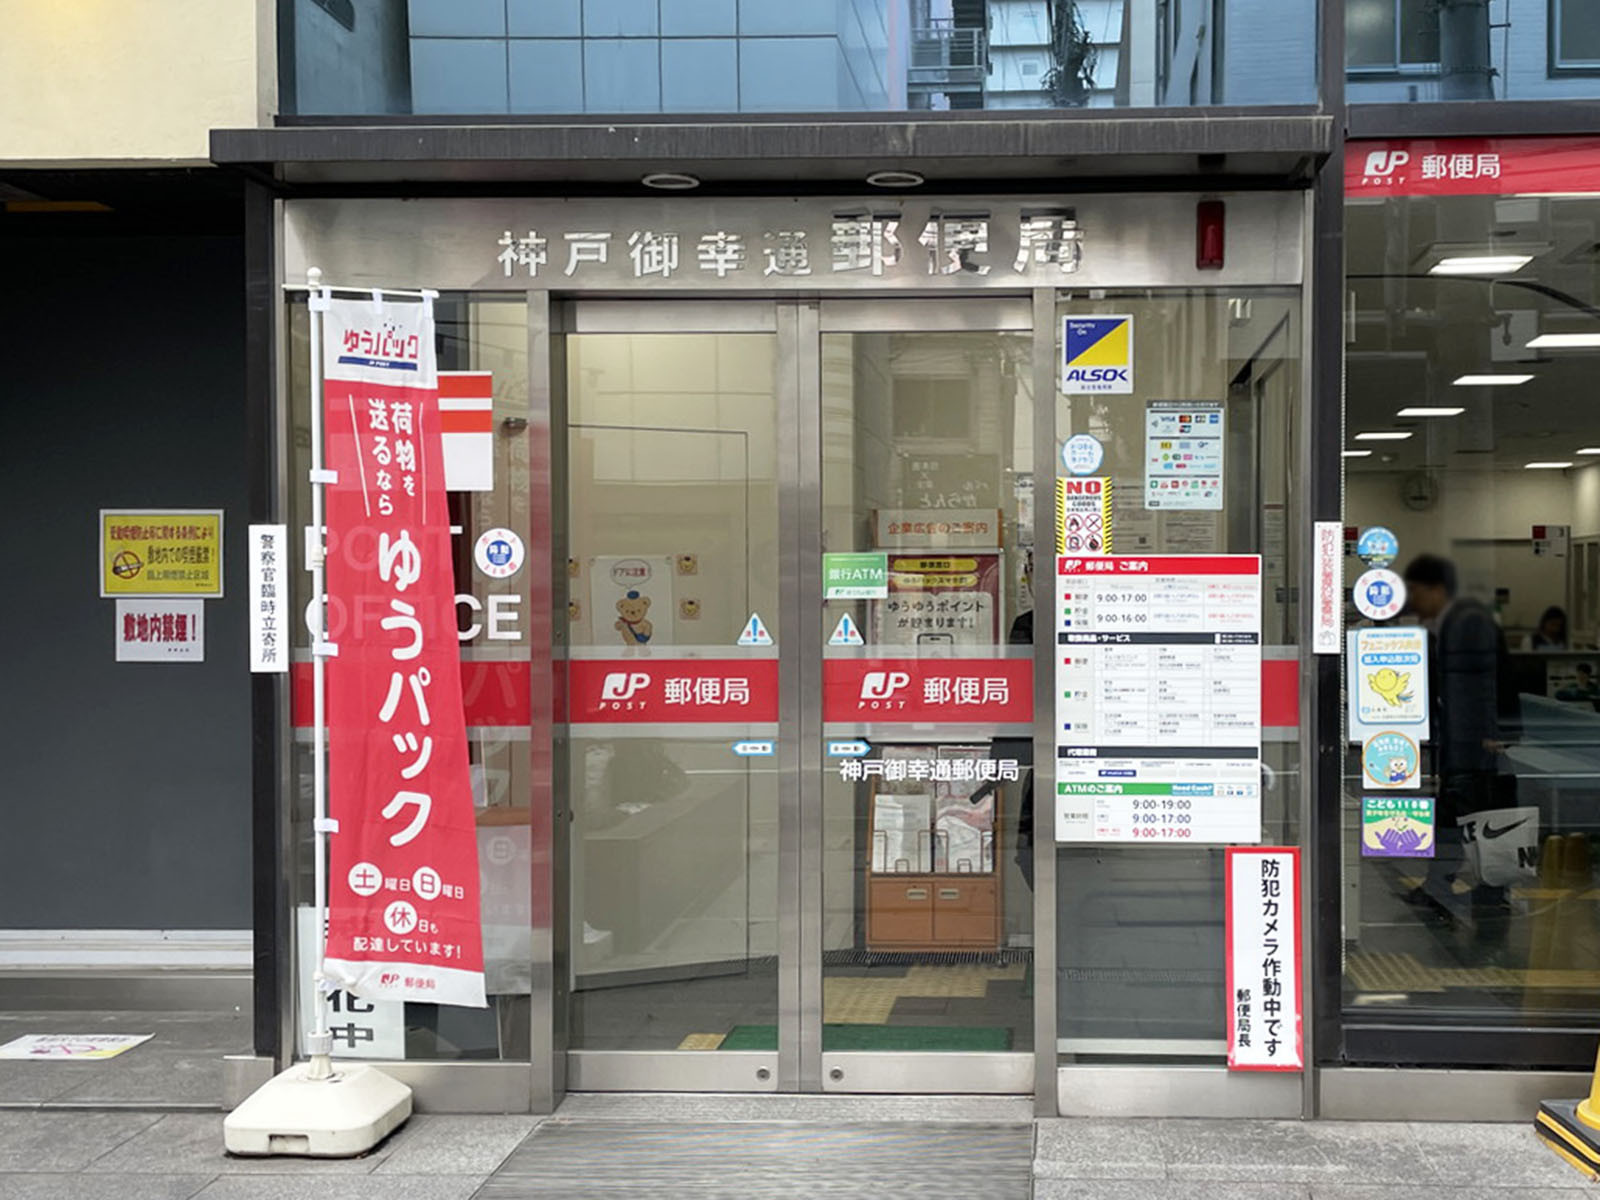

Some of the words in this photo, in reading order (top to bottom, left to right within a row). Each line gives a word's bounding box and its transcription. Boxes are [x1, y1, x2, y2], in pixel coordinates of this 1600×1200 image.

[1421, 154, 1500, 179] 郵便局
[497, 208, 1085, 277] 神戸御幸通郵便局
[343, 329, 419, 359] ゆうパック
[1066, 369, 1128, 382] ALSOK
[368, 398, 393, 515] 送るなら
[391, 402, 416, 496] 荷物を
[1067, 481, 1101, 494] NO
[888, 522, 989, 535] 企業広告のご案内
[828, 568, 884, 582] 銀行ATM
[1085, 561, 1114, 571] 郵便局
[1120, 561, 1148, 571] ご案内
[260, 534, 277, 663] 警察官臨時立寄所
[888, 600, 984, 612] ゆうゆうポイント
[378, 529, 433, 847] ゆうパック
[664, 678, 750, 705] 郵便局
[923, 677, 1009, 705] 郵便局
[598, 701, 646, 710] POST
[858, 701, 906, 709] POST
[839, 759, 1019, 781] 神戸御幸通郵便局
[1064, 785, 1123, 794] ATMのご案内
[1133, 800, 1191, 809] 9:00-19:00
[1133, 814, 1191, 823] 9:00-17:00
[1133, 828, 1191, 837] 9:00-17:00
[353, 937, 461, 959] 配達しています!
[1261, 859, 1282, 1057] 防犯カメラ作動中です
[1237, 989, 1251, 1047] 郵便局長
